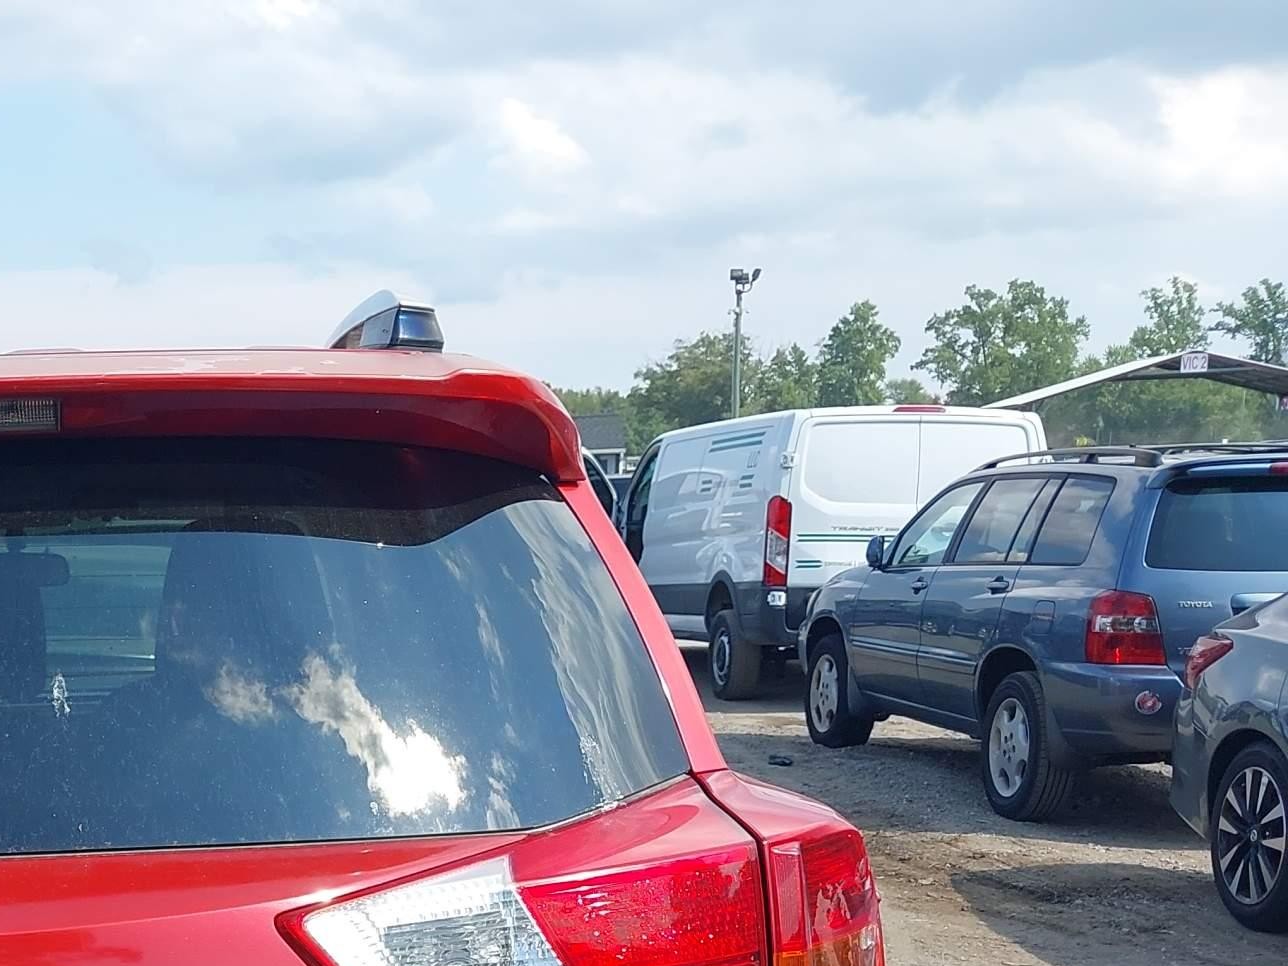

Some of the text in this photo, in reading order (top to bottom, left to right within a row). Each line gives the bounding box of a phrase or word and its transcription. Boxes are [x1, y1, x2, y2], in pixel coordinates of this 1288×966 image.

[1182, 356, 1207, 369] VIC 2
[1177, 600, 1214, 609] TOYOTA
